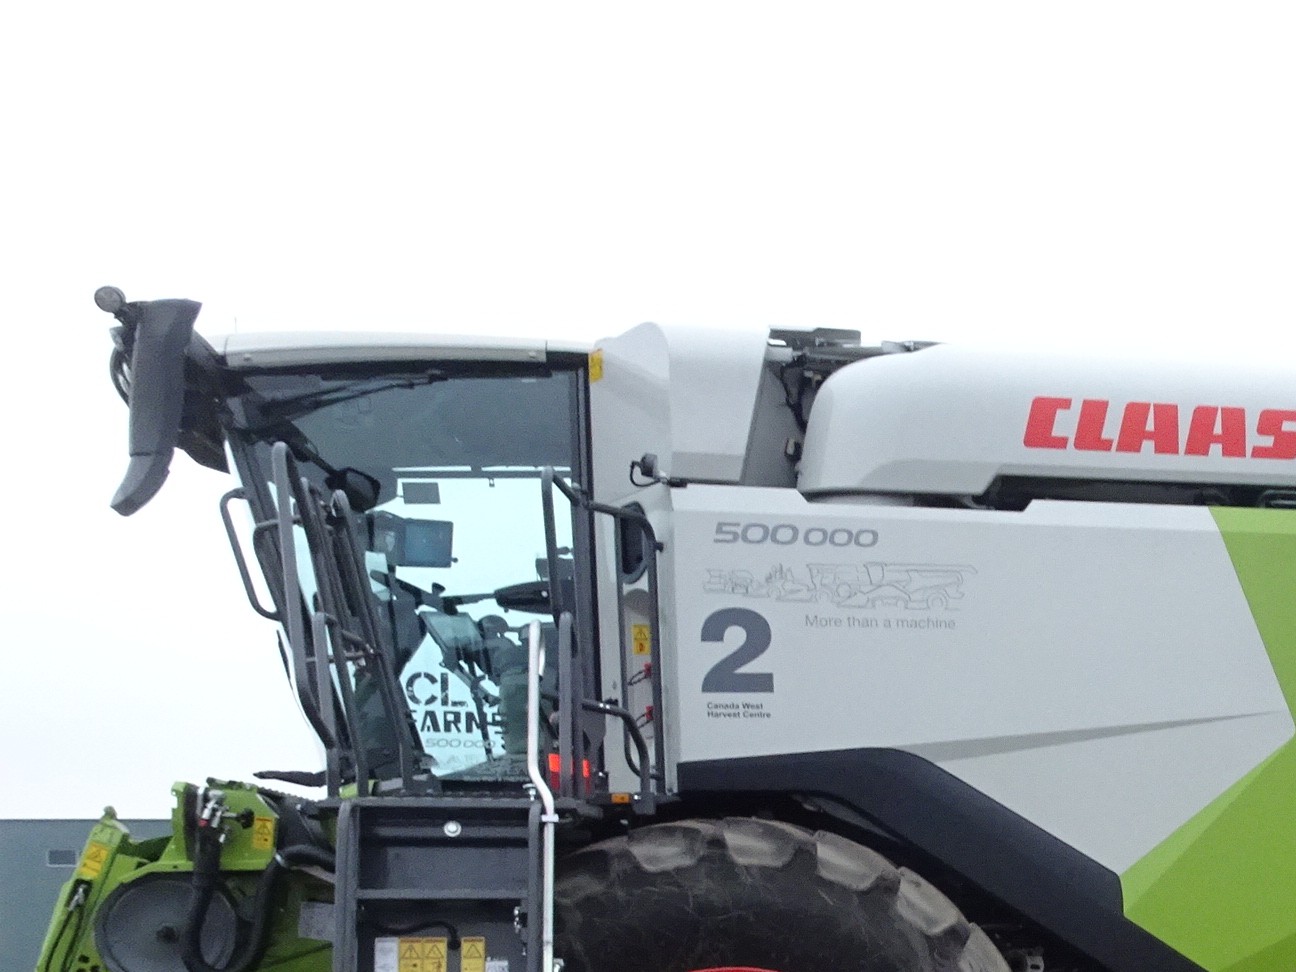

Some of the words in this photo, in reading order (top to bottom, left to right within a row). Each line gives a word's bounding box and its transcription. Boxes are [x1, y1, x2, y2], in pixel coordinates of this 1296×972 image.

[805, 614, 842, 627] More
[847, 616, 879, 628] than
[883, 618, 891, 628] a
[896, 617, 956, 630] machine
[701, 606, 775, 693] 2
[707, 702, 740, 710] Canada
[741, 702, 764, 710] West
